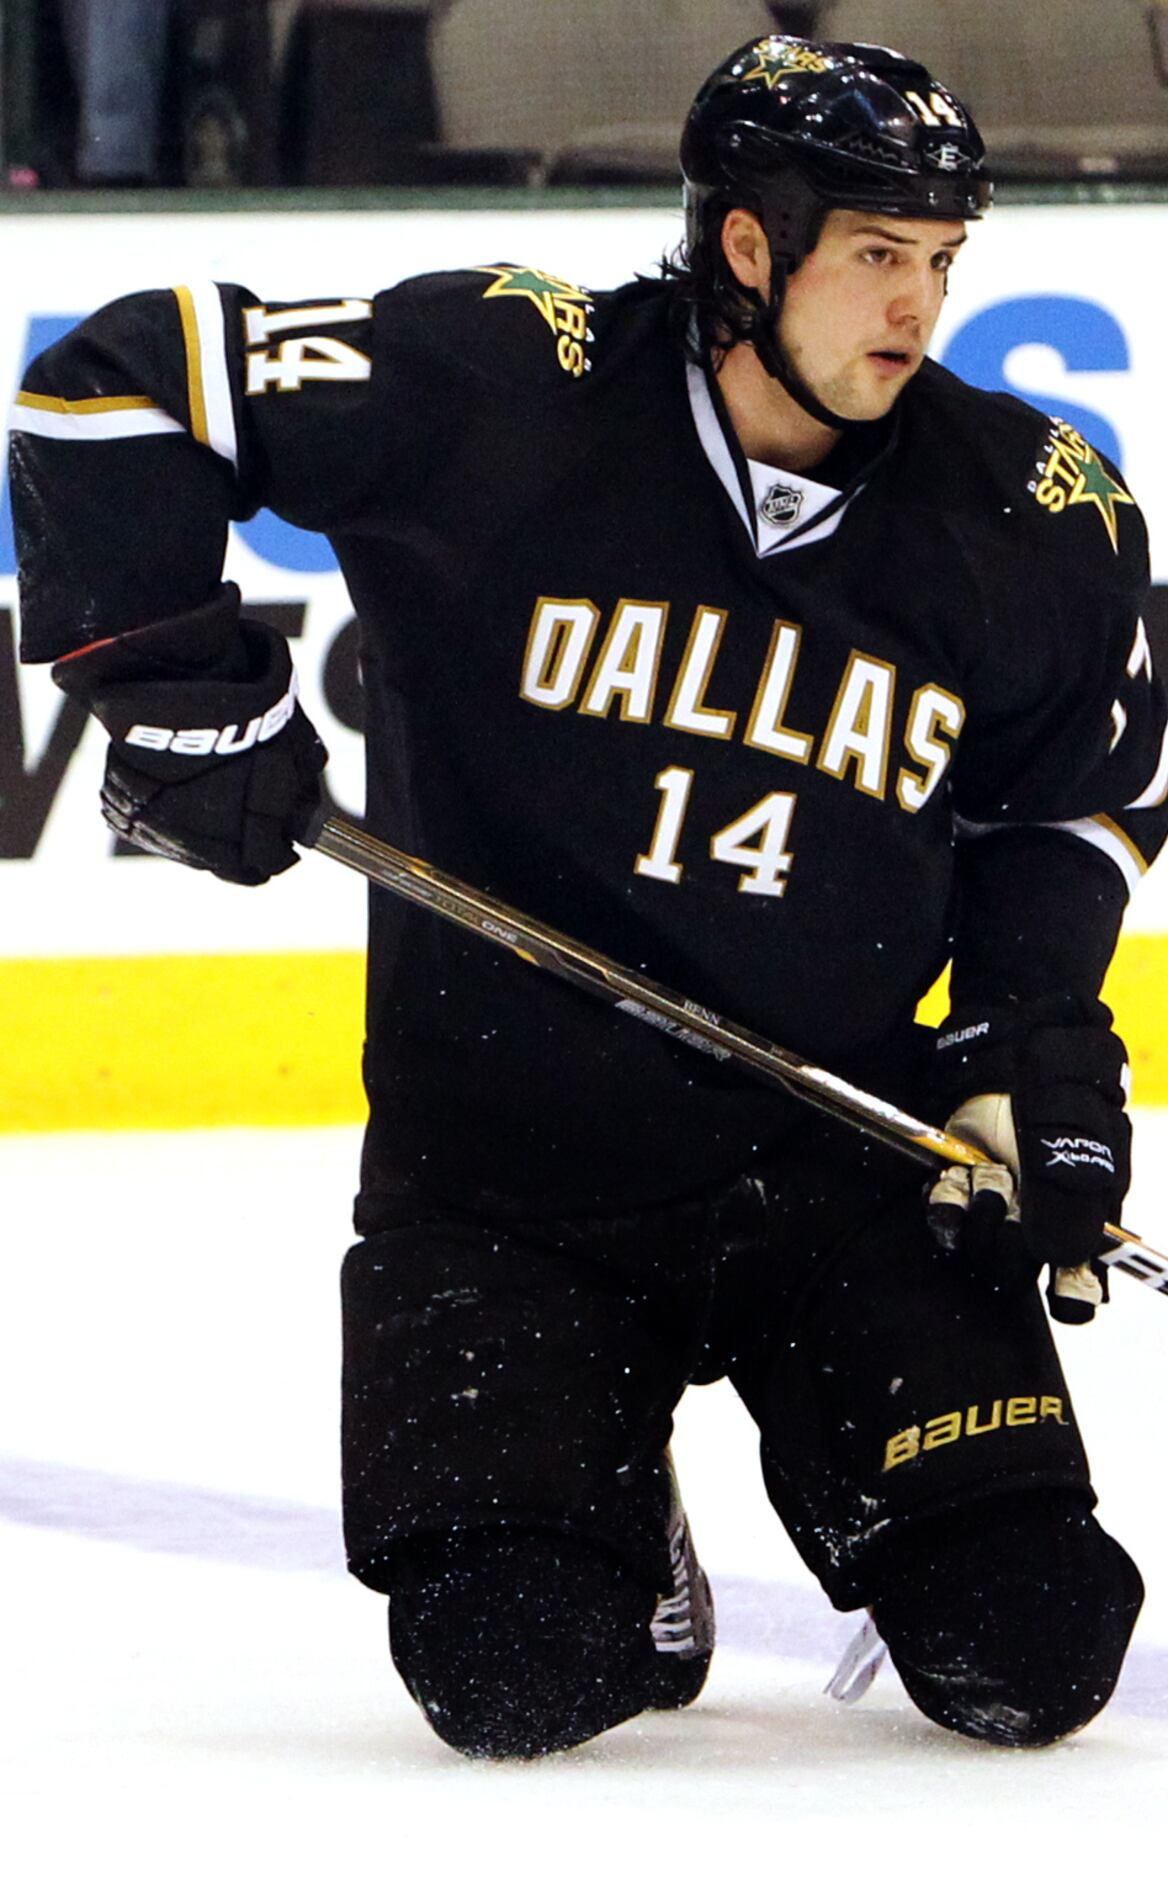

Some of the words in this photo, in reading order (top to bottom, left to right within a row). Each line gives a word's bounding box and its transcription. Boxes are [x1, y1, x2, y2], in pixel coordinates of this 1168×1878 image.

[905, 91, 962, 127] 14
[241, 299, 374, 396] 14
[1035, 423, 1086, 513] STAR
[519, 596, 967, 814] DALLAS
[634, 764, 797, 897] 14
[683, 1000, 721, 1026] BENN
[882, 1395, 1069, 1473] BAUER
